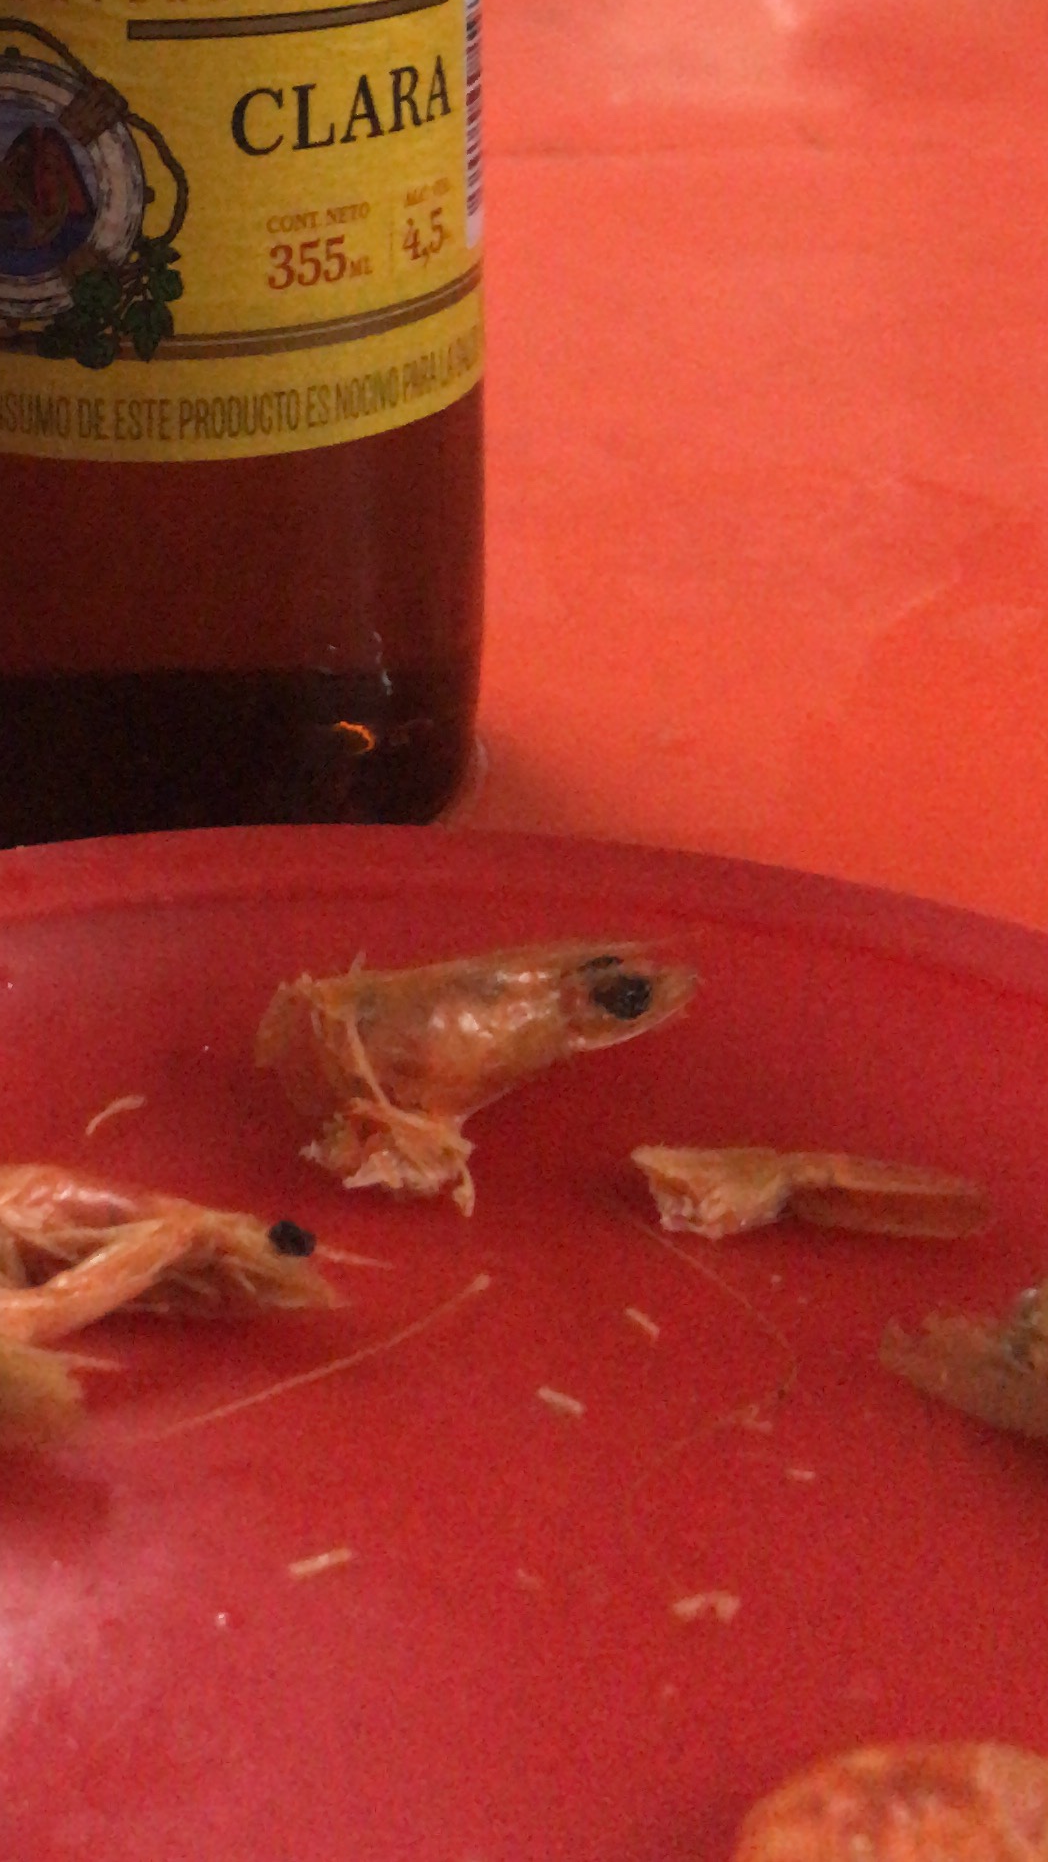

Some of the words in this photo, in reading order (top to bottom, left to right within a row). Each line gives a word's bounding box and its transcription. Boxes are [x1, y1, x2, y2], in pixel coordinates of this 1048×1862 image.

[230, 54, 453, 158] CLARA
[77, 397, 111, 441] DE
[114, 398, 171, 441] ESTE
[179, 387, 301, 440] PRODUCTO
[307, 384, 331, 429] ES
